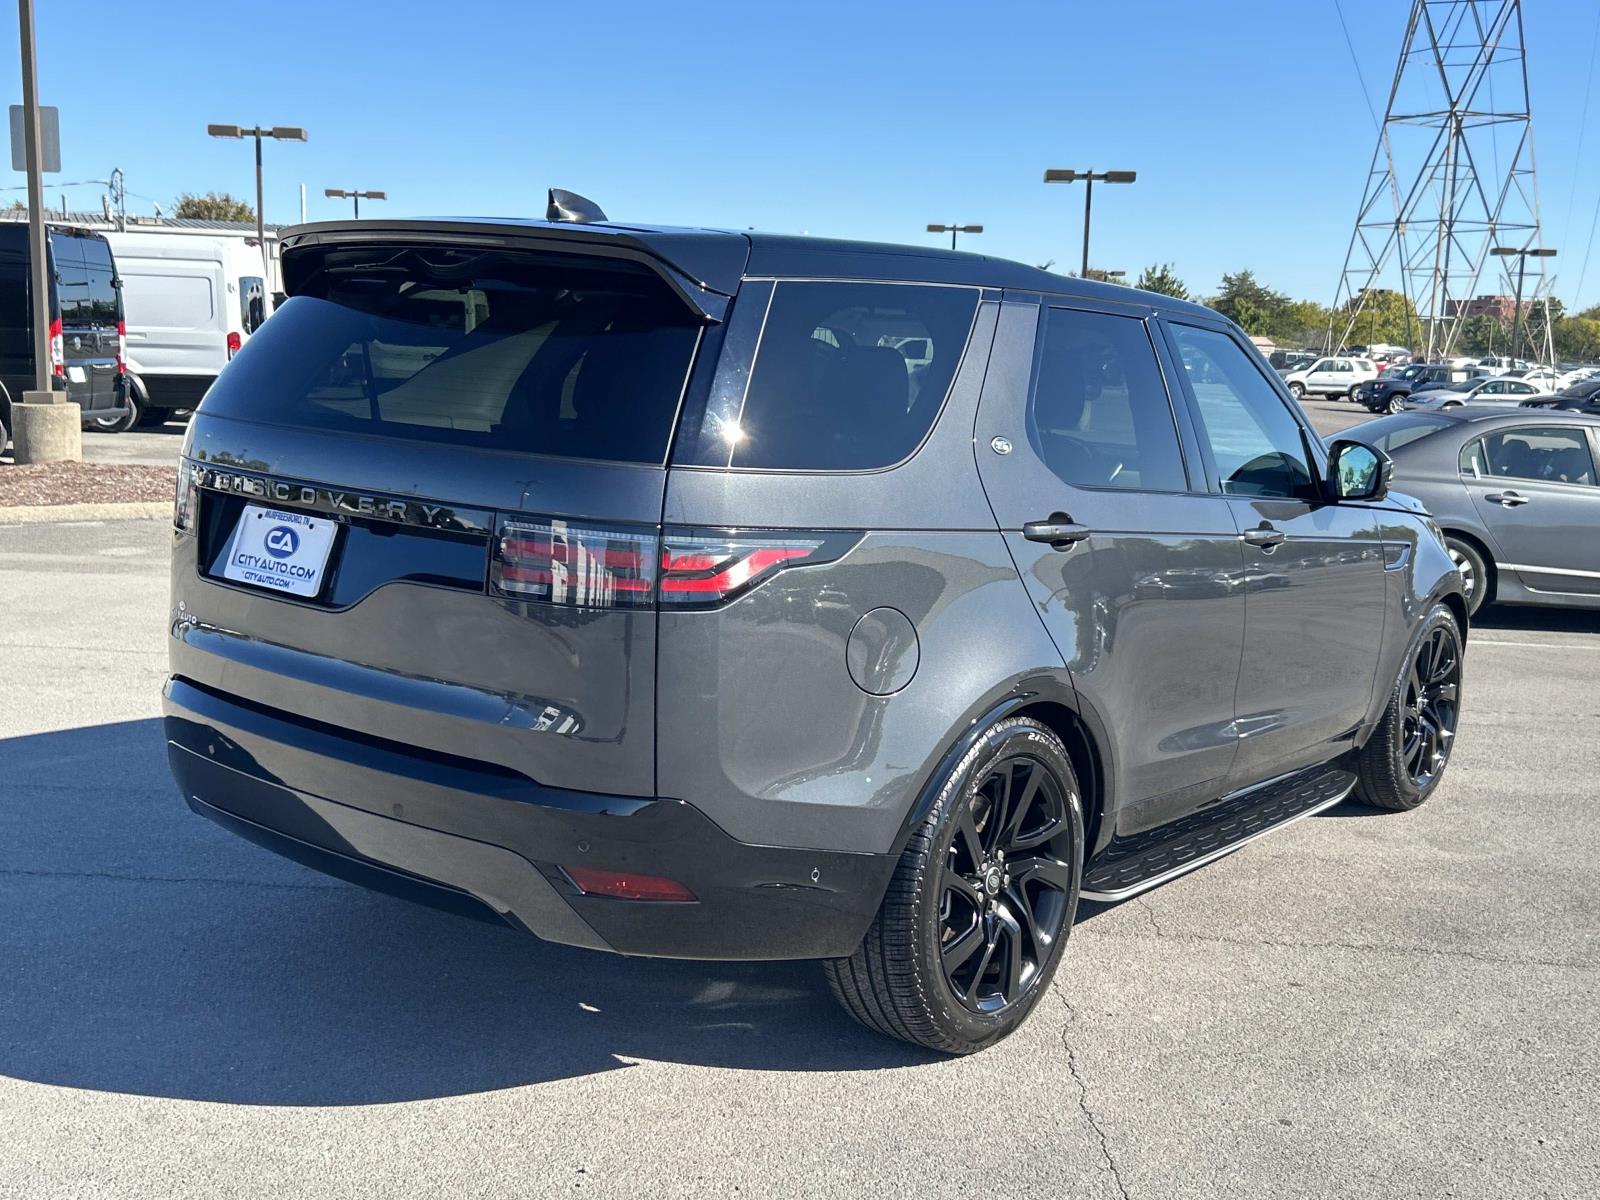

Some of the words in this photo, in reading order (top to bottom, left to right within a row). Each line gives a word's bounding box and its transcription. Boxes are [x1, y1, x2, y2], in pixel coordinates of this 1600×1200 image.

[214, 471, 441, 524] DISCOVERY
[267, 530, 294, 553] CA
[238, 553, 316, 580] CITYAUTO.COM
[244, 571, 291, 588] CITYAUTO.COM
